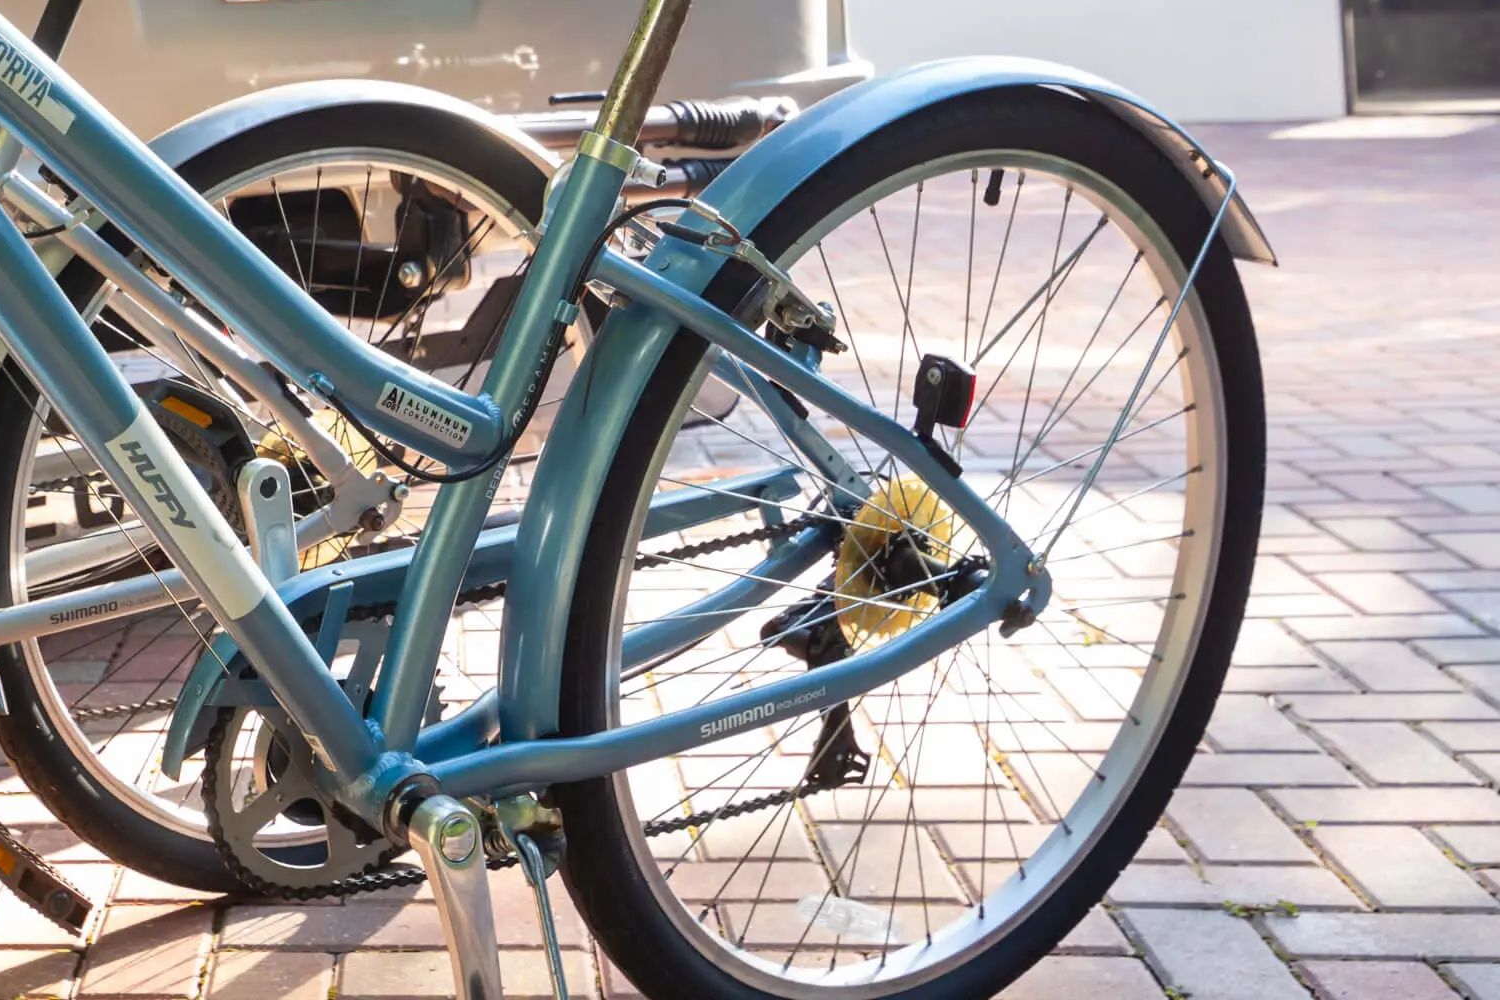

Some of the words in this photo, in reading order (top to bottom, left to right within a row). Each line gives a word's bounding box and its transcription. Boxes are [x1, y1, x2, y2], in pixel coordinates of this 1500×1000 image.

[403, 408, 464, 442] CONSTRUCTION
[407, 399, 468, 434] ALUMINUM
[119, 441, 197, 529] HUFFY
[49, 601, 118, 625] SHIMANO
[700, 702, 775, 739] SHIMANO
[776, 685, 826, 711] equipped
